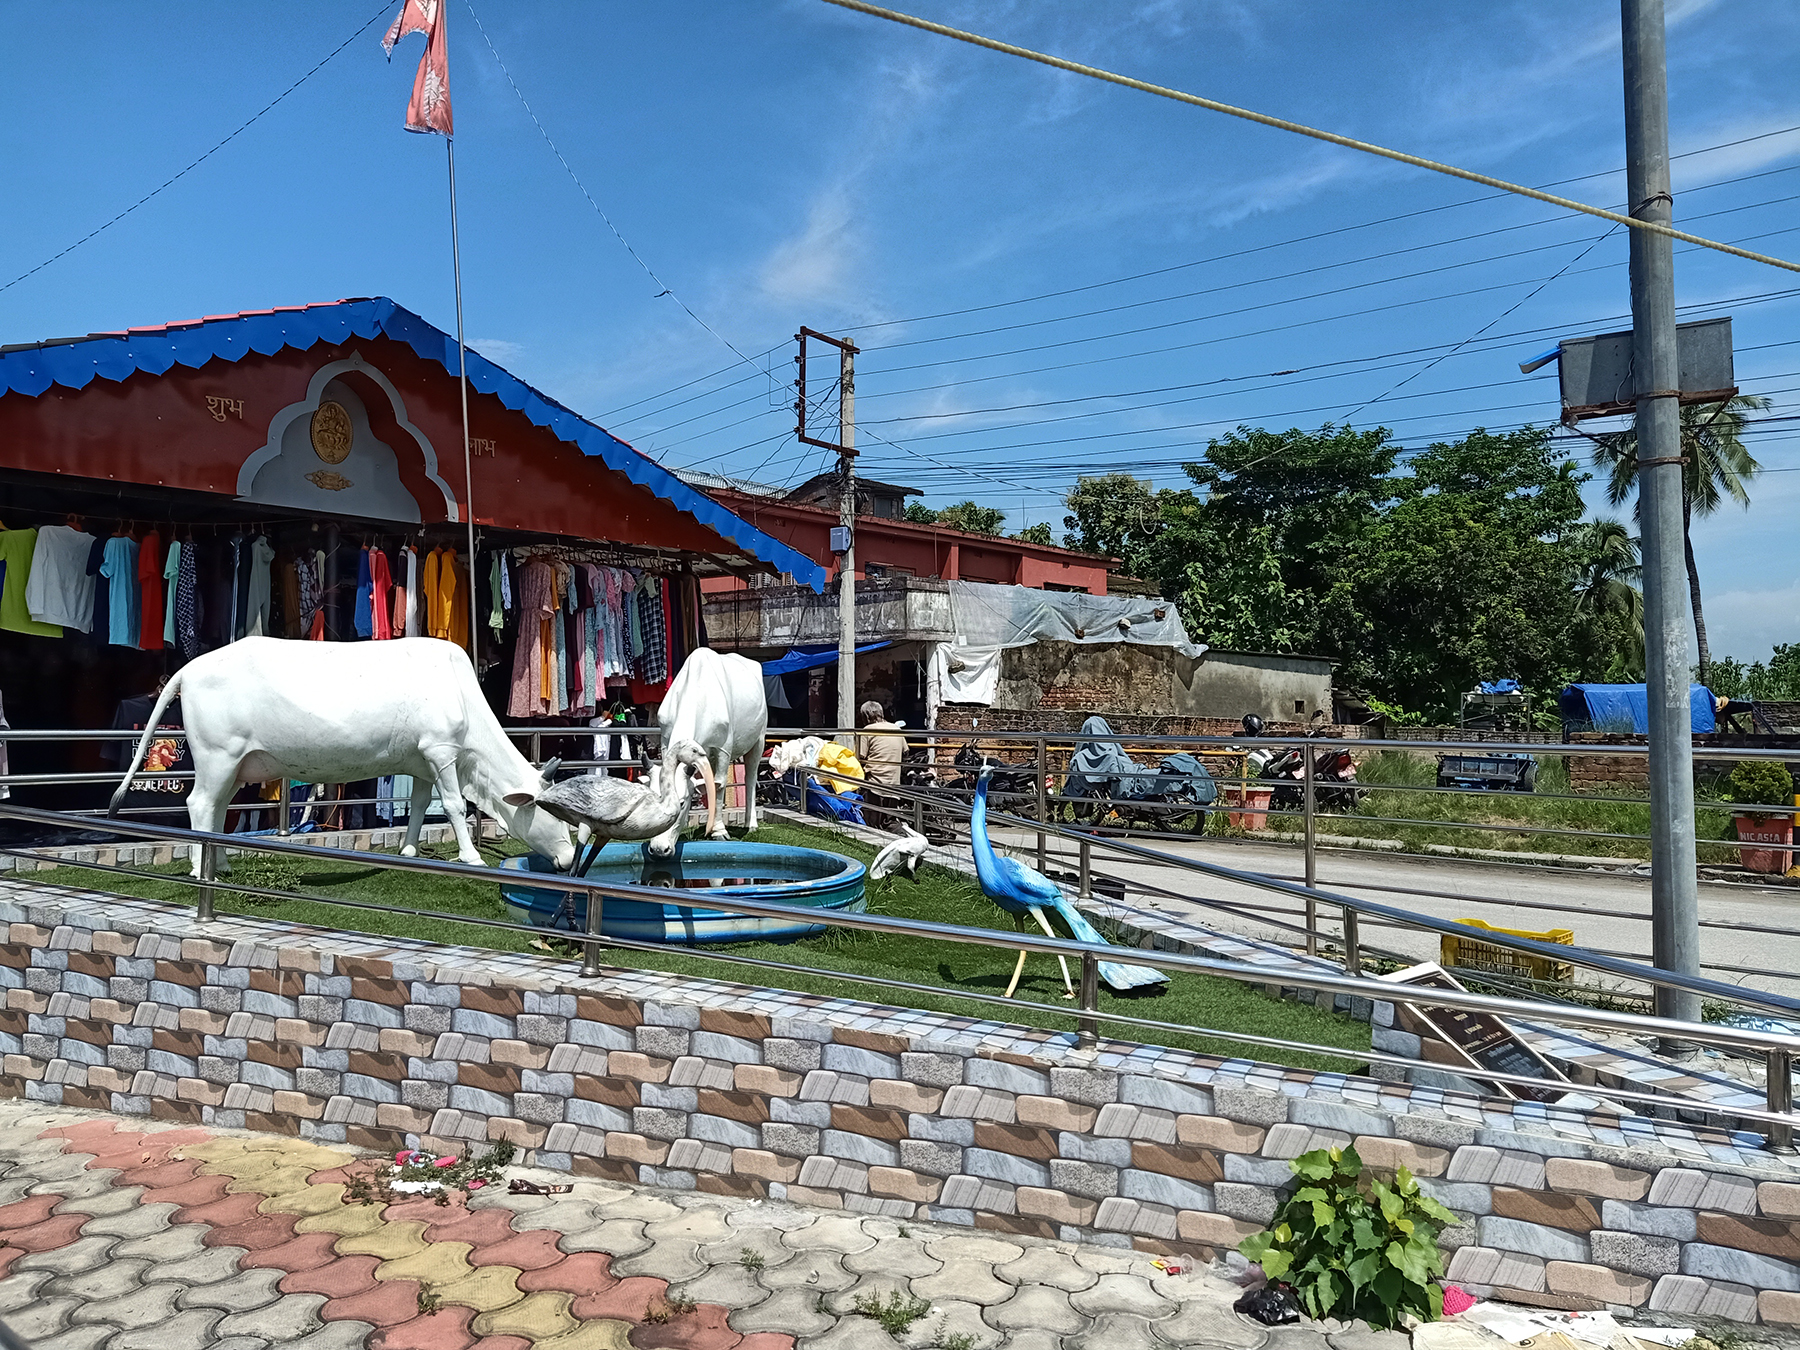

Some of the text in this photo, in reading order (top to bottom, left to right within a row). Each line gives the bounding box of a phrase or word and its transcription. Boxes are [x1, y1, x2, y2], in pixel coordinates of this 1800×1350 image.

[205, 395, 245, 422] शुभ
[1740, 832, 1755, 841] NIC
[1757, 833, 1780, 842] ASIA
